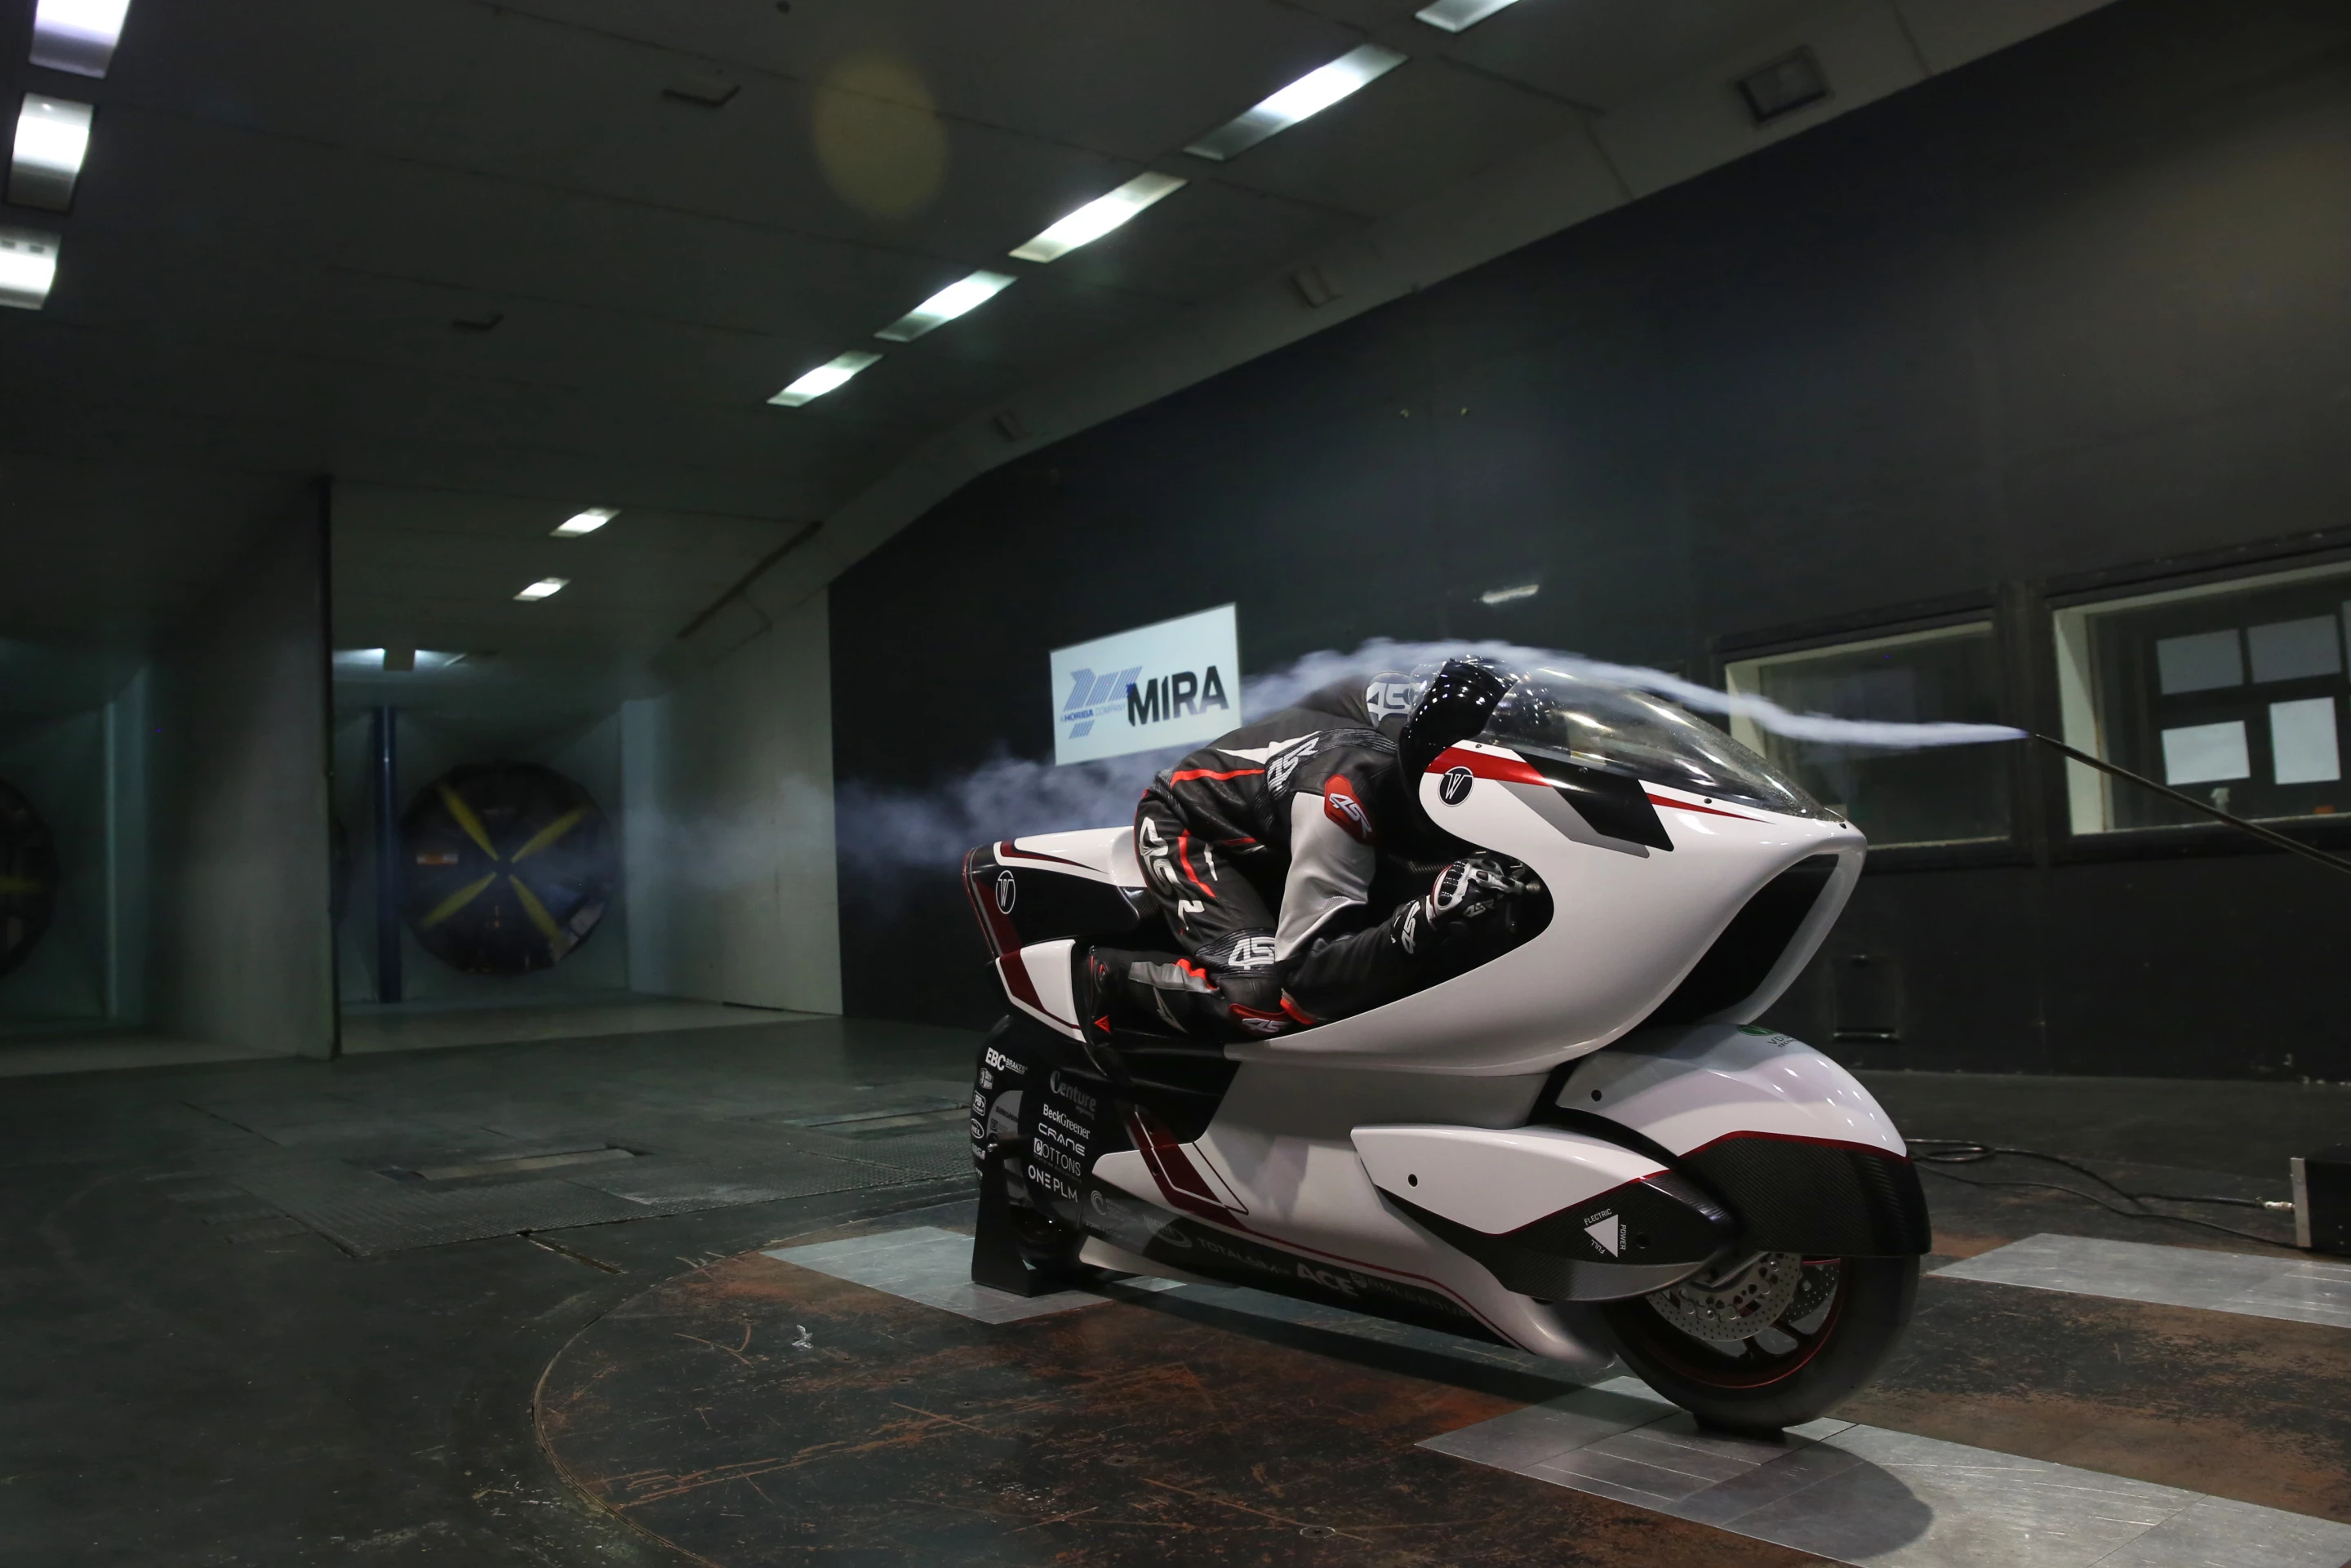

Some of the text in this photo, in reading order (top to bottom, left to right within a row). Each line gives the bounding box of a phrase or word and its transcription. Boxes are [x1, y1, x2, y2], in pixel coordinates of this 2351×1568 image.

[1127, 665, 1229, 727] MIRA
[1064, 708, 1094, 722] HORIBA
[985, 1046, 1006, 1071] EBC
[1043, 1103, 1091, 1139] BeckGreener
[1033, 1137, 1082, 1176] COTTONS
[1038, 1122, 1085, 1157] CRANE
[1028, 1164, 1051, 1189] ONE
[1053, 1177, 1078, 1203] PLM
[1591, 1239, 1606, 1255] FULL
[1296, 1262, 1359, 1297] ACE
